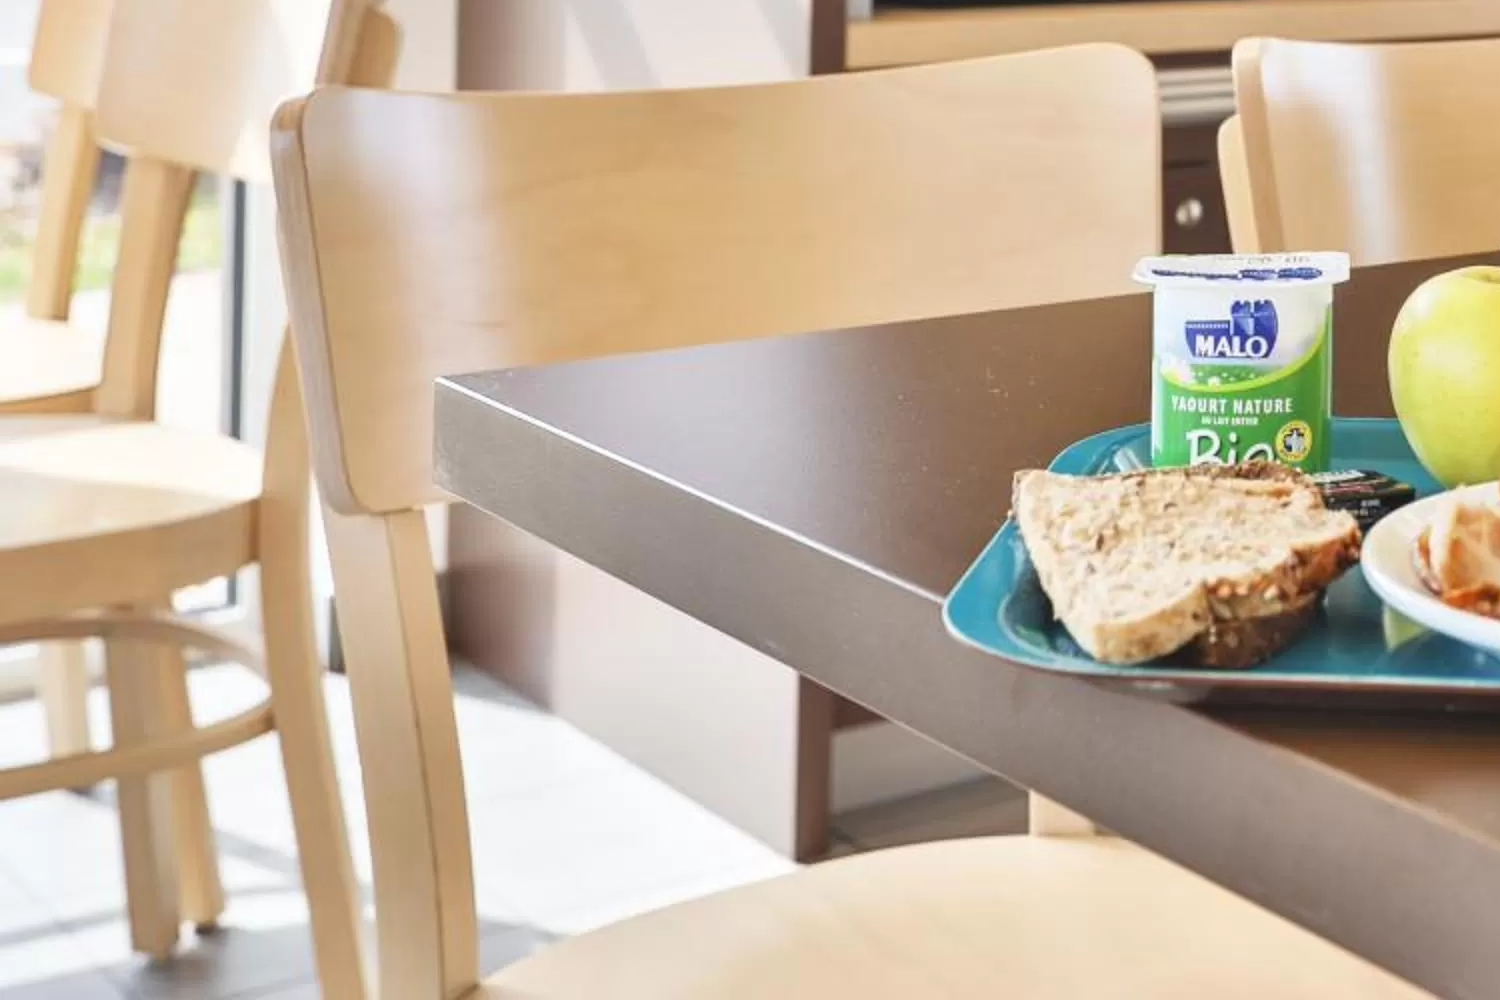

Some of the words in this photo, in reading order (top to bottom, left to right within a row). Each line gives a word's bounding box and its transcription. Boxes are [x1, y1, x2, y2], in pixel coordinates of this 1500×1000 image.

[1194, 336, 1268, 358] MALO
[1171, 395, 1227, 414] YAOURT
[1233, 396, 1294, 415] NATURE
